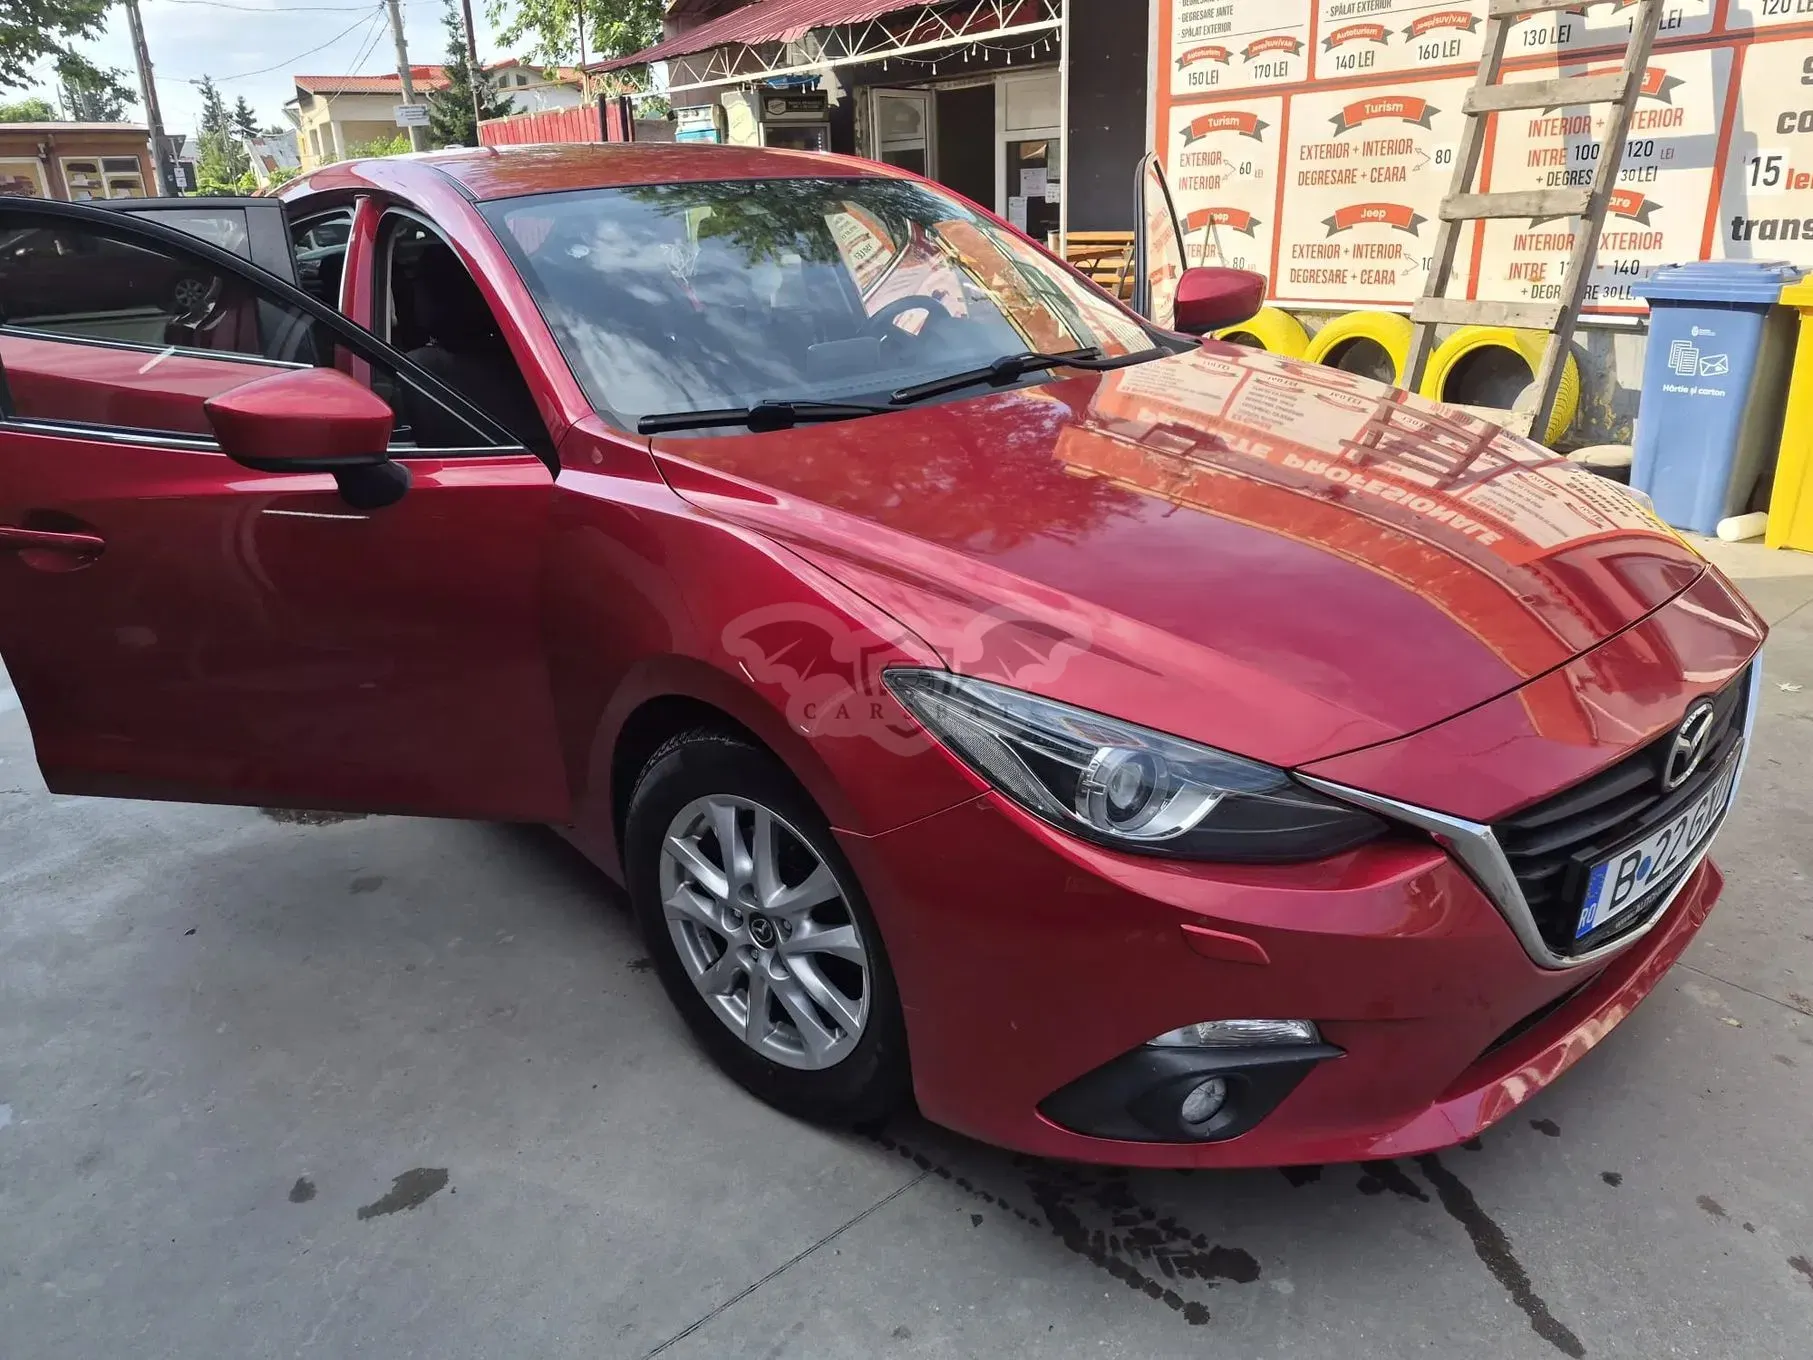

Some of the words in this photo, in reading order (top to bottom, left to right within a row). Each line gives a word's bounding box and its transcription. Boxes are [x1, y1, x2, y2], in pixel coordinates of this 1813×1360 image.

[1202, 22, 1232, 36] EXTERIOR
[1658, 9, 1683, 31] LEI
[1523, 28, 1547, 47] 130
[1550, 25, 1572, 45] LEI
[1419, 43, 1439, 60] 160
[1442, 39, 1461, 58] LEI
[1336, 54, 1355, 70] 140
[1358, 50, 1375, 67] LEI
[1188, 71, 1204, 86] 150
[1205, 69, 1219, 85] LEI
[1254, 64, 1271, 79] 170
[1273, 60, 1288, 77] LEI
[1364, 101, 1404, 114] Turism
[1208, 115, 1240, 127] Turism
[1528, 115, 1592, 138] INTERIOR
[1630, 107, 1684, 130] TERIOR
[1299, 142, 1350, 161] EXTERIOR
[1361, 138, 1413, 157] INTERIOR
[1435, 148, 1451, 164] 80
[1527, 147, 1568, 168] INTRE
[1574, 143, 1600, 161] 100
[1627, 140, 1654, 158] 120
[1660, 147, 1675, 160] LEI
[1179, 151, 1222, 168] EXTERIOR
[1239, 161, 1252, 175] 60
[1298, 168, 1358, 187] DEGRESARE
[1370, 166, 1406, 184] CEARA
[1546, 169, 1594, 187] DEGRES
[1620, 169, 1636, 181] 30
[1637, 166, 1658, 182] LEI
[1751, 155, 1783, 187] 15
[1785, 168, 1813, 191] le
[1178, 174, 1221, 191] INTERIOR
[1211, 212, 1230, 222] eep
[1360, 208, 1387, 220] Jeep
[1513, 233, 1576, 251] INTERIOR
[1599, 231, 1664, 250] XTERIOR
[1185, 244, 1217, 258] TERIOR
[1292, 243, 1341, 260] EXTERIOR
[1352, 243, 1402, 260] INTERIOR
[1232, 257, 1245, 270] 80
[1508, 262, 1548, 280] INTRE
[1613, 259, 1640, 276] 140
[1290, 268, 1348, 284] DEGRESARE
[1360, 269, 1396, 285] CEARA
[1602, 286, 1617, 299] 30
[1609, 849, 1642, 911] B
[1645, 815, 1687, 886] 22
[1579, 904, 1597, 930] RO
